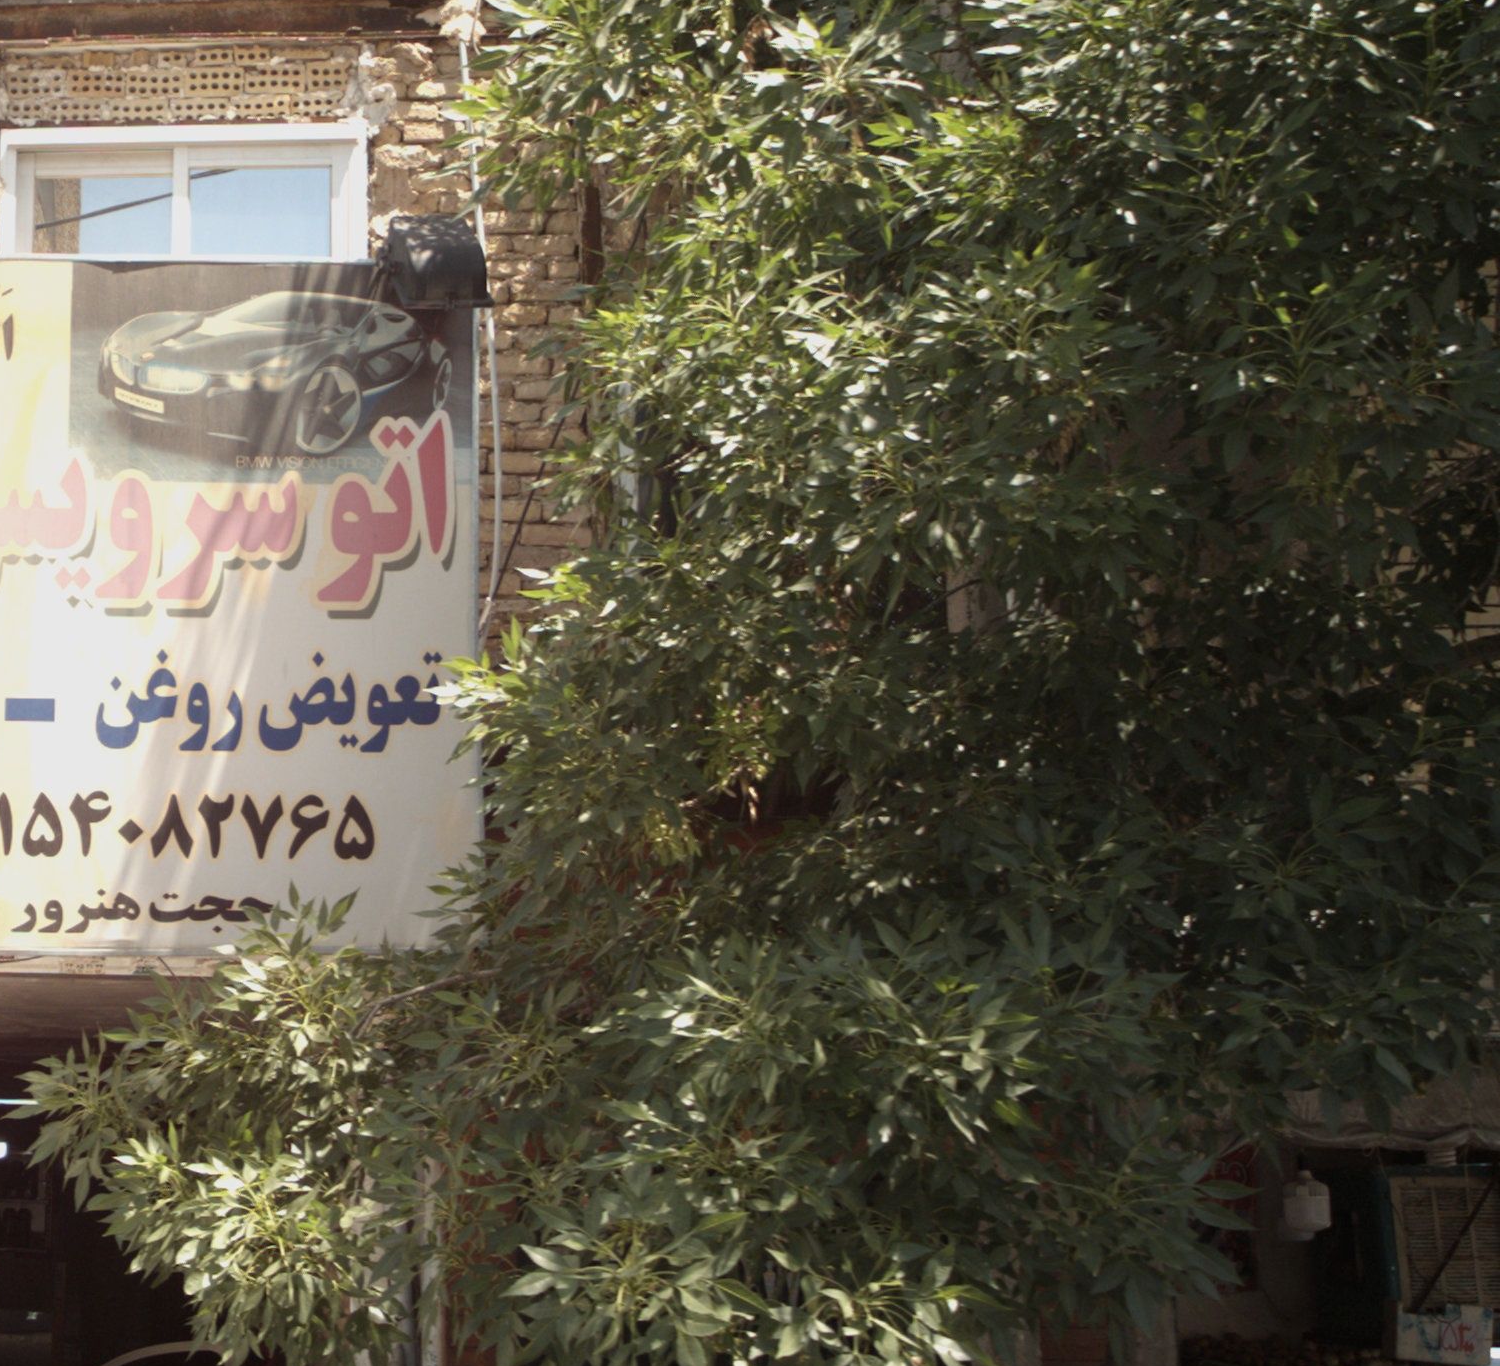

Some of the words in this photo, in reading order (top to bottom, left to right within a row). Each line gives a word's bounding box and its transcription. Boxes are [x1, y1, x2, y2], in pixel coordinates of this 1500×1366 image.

[235, 455, 273, 469] BMW
[315, 413, 454, 607] اتو
[95, 649, 244, 752] روغن
[258, 651, 443, 753] تعویض
[11, 888, 141, 933] هنرور
[149, 892, 274, 934] حجت
